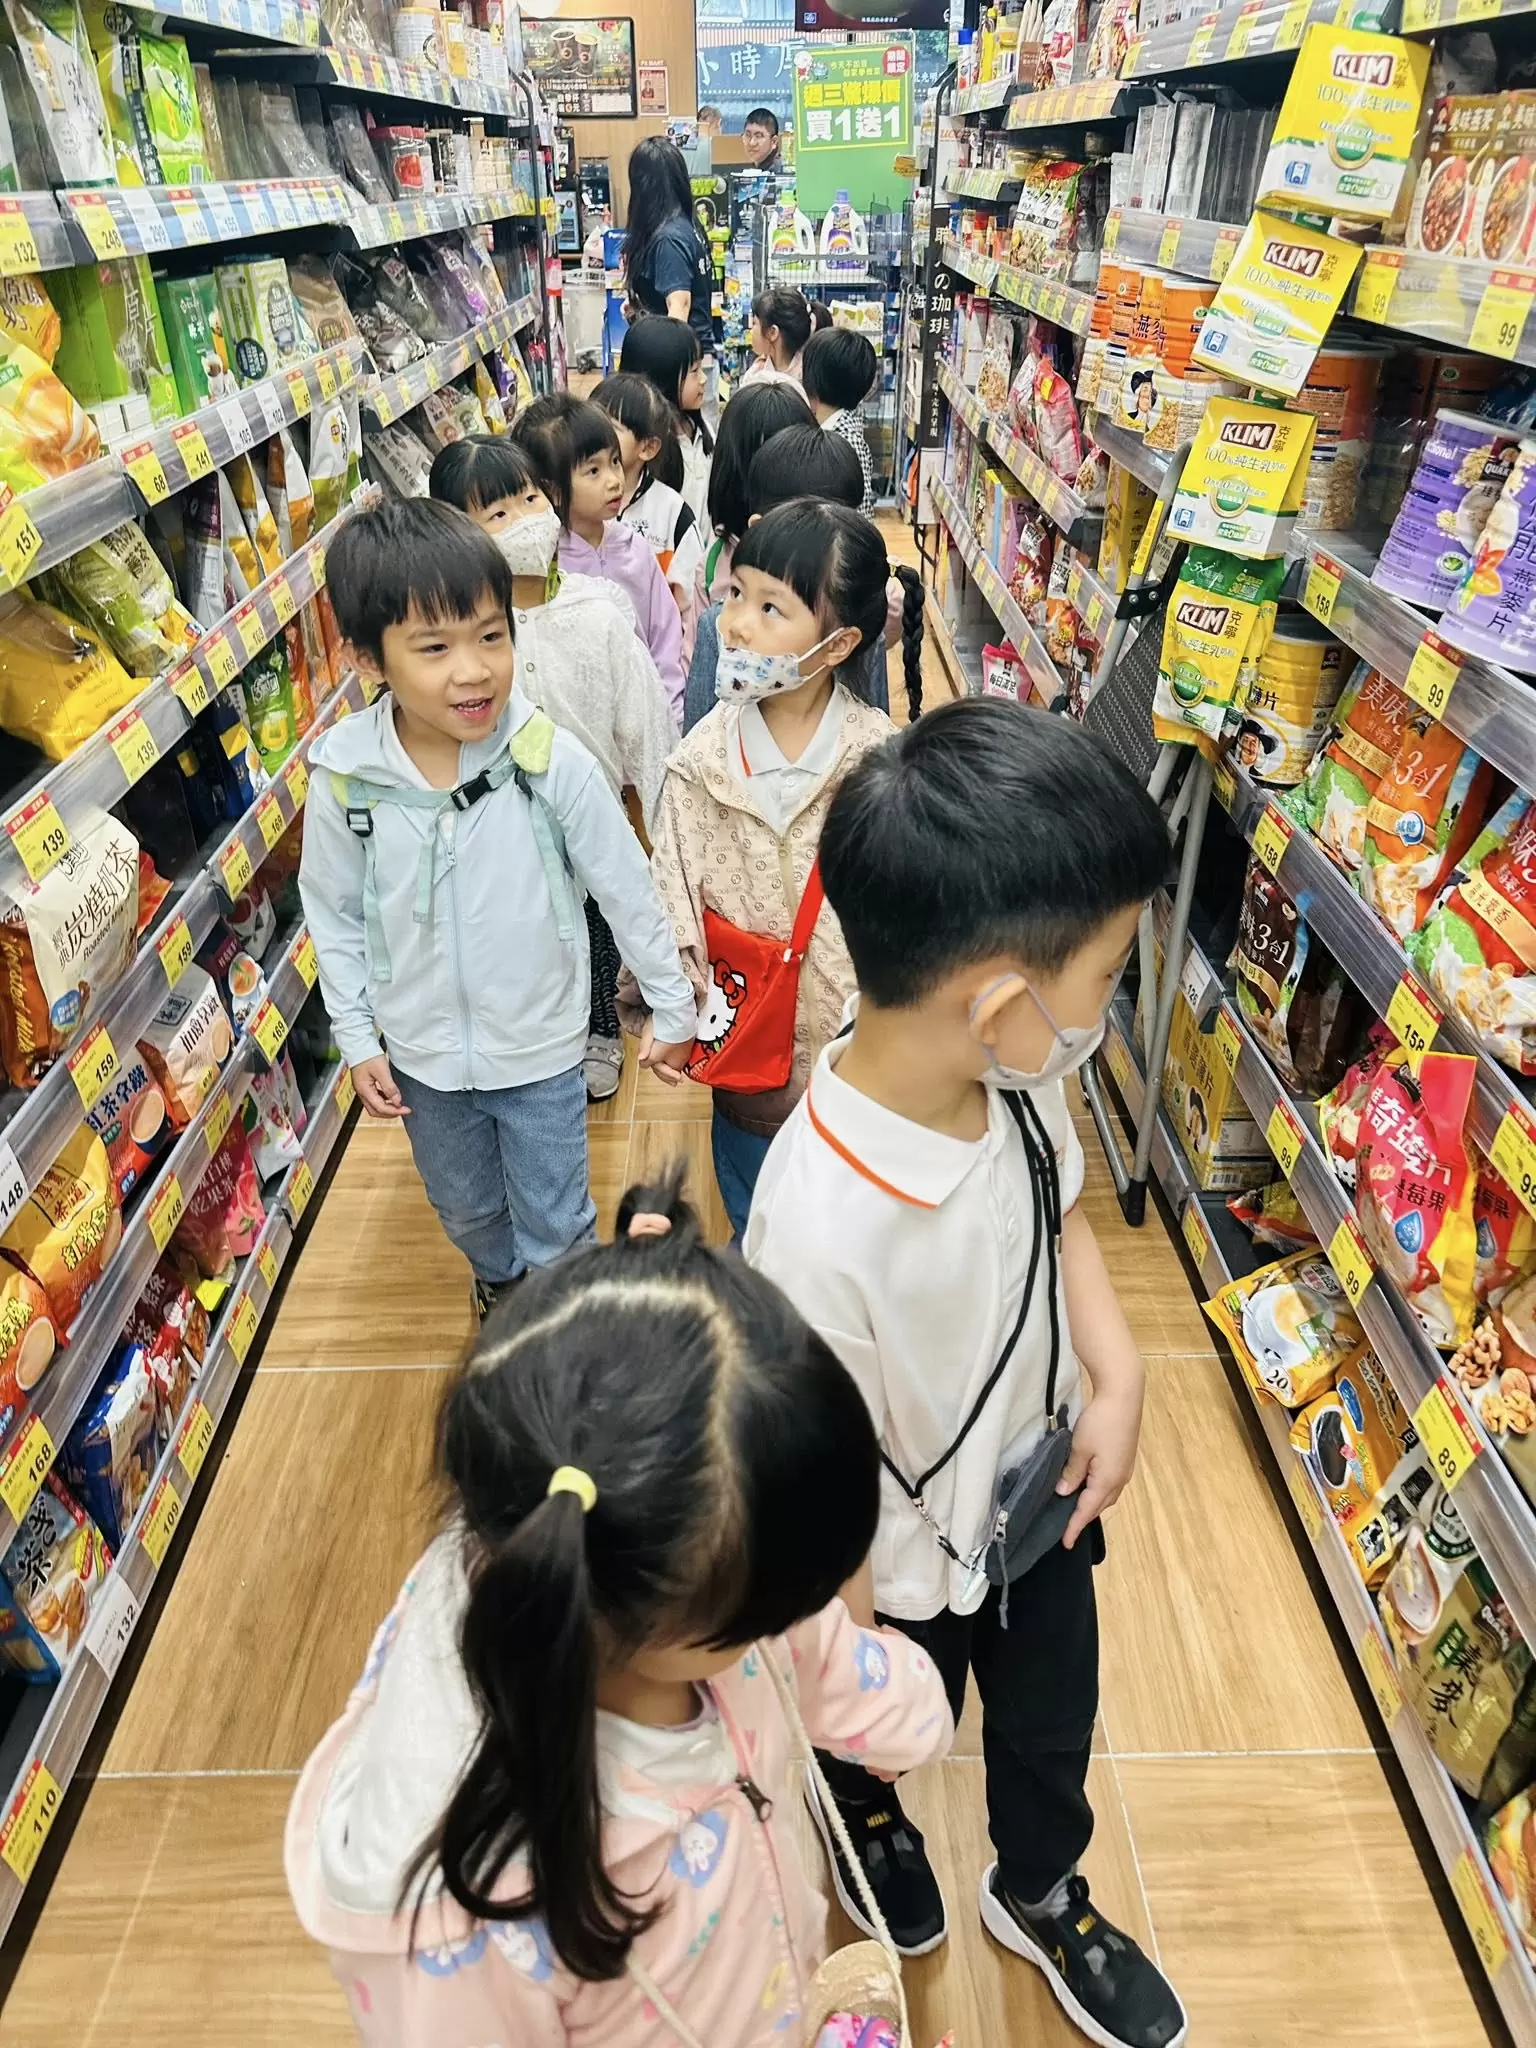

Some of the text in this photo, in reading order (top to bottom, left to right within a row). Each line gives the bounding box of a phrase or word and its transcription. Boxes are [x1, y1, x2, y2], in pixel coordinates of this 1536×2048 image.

[1334, 55, 1391, 85] KLIM
[806, 105, 901, 143] 買1送1
[102, 229, 122, 250] 248
[14, 242, 37, 264] 132
[1265, 243, 1321, 276] KLIM
[1372, 293, 1387, 314] 99
[1498, 321, 1518, 348] 99
[1222, 424, 1273, 449] KLIM
[195, 451, 210, 469] 141
[153, 473, 166, 494] 68
[16, 525, 37, 557] 151
[1314, 592, 1331, 618] 158
[1178, 603, 1228, 634] KLIM
[191, 687, 207, 708] 118
[1428, 683, 1445, 709] 99
[137, 741, 156, 766] 139
[271, 815, 284, 835] 169
[42, 828, 66, 858] 139
[1263, 843, 1279, 868] 158
[237, 861, 251, 883] 169
[63, 837, 139, 961] 炭燒奶茶
[177, 941, 194, 968] 159
[271, 1021, 287, 1044] 169
[1403, 1023, 1426, 1052] 158
[1222, 1042, 1235, 1068] 158
[95, 1053, 115, 1084] 159
[1280, 1145, 1293, 1170] 99
[0, 1180, 24, 1219] 148
[167, 1198, 183, 1229] 148
[1345, 1270, 1361, 1296] 99
[246, 1312, 258, 1334] 79
[1266, 1369, 1289, 1391] 20
[196, 1423, 214, 1454] 118
[28, 1442, 53, 1484] 168
[1438, 1446, 1458, 1480] 89
[163, 1500, 181, 1537] 109
[116, 1603, 137, 1643] 132
[32, 1787, 58, 1836] 110
